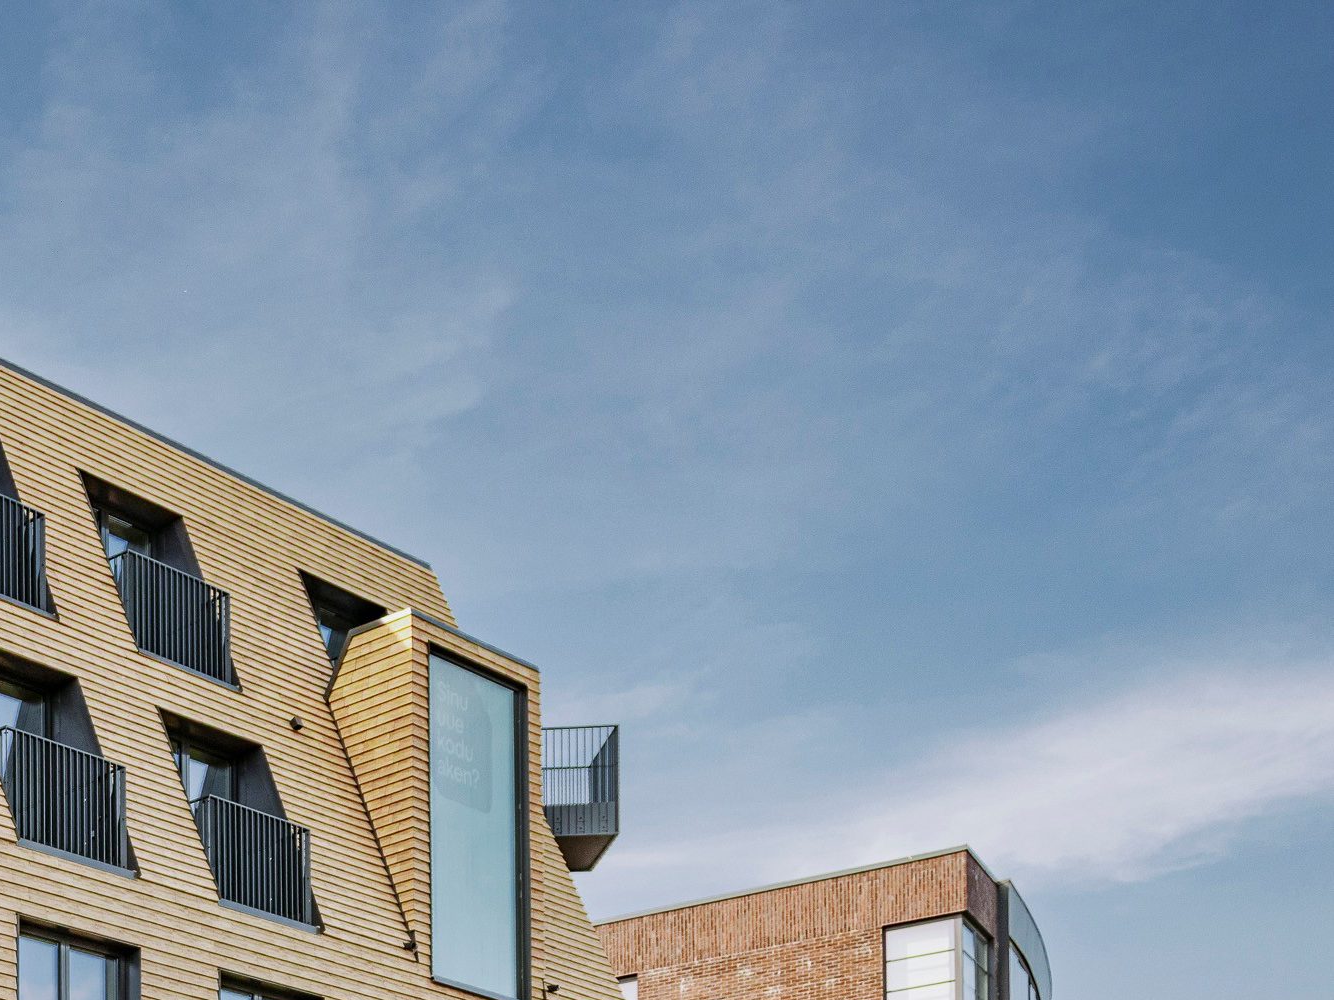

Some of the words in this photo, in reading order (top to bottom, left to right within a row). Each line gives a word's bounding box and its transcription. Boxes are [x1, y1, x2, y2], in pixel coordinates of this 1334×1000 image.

[436, 681, 469, 712] Sinu
[436, 731, 474, 762] kodu
[436, 759, 480, 789] aken?
